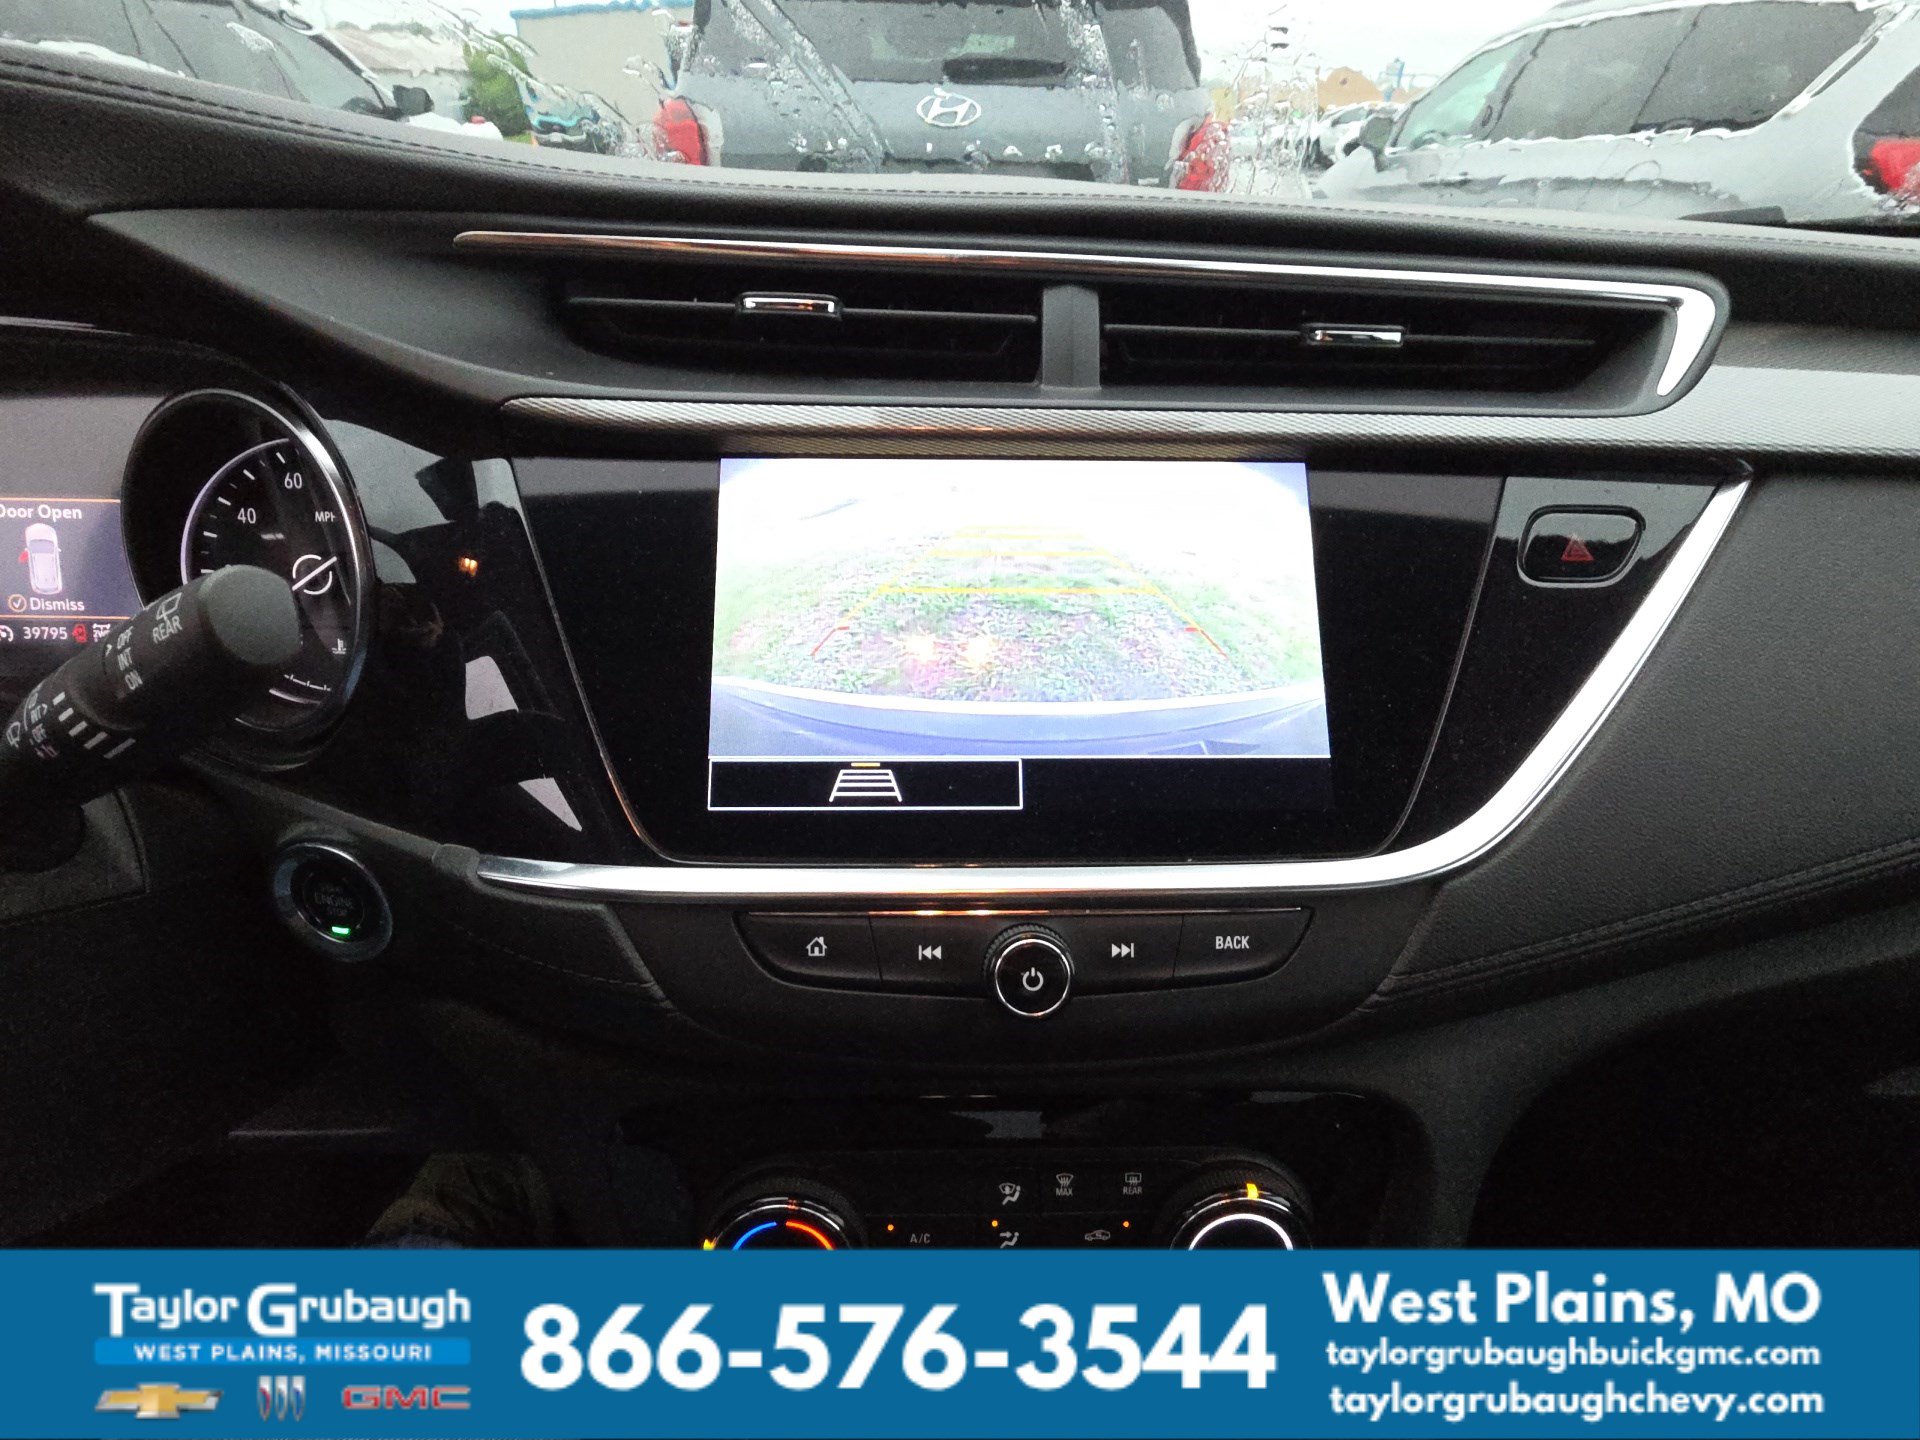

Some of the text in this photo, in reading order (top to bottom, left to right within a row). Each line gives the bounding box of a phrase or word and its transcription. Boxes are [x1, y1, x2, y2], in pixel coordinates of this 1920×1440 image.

[284, 472, 302, 489] 60
[0, 504, 82, 522] Door Open
[238, 508, 256, 524] 40
[29, 597, 85, 611] Dismiss
[23, 626, 68, 640] 39795
[152, 615, 182, 644] REAR
[125, 670, 143, 690] ON
[1215, 935, 1250, 950] BACK
[1055, 1187, 1073, 1197] MAX
[1122, 1186, 1142, 1195] REAR
[910, 1233, 931, 1244] A/C
